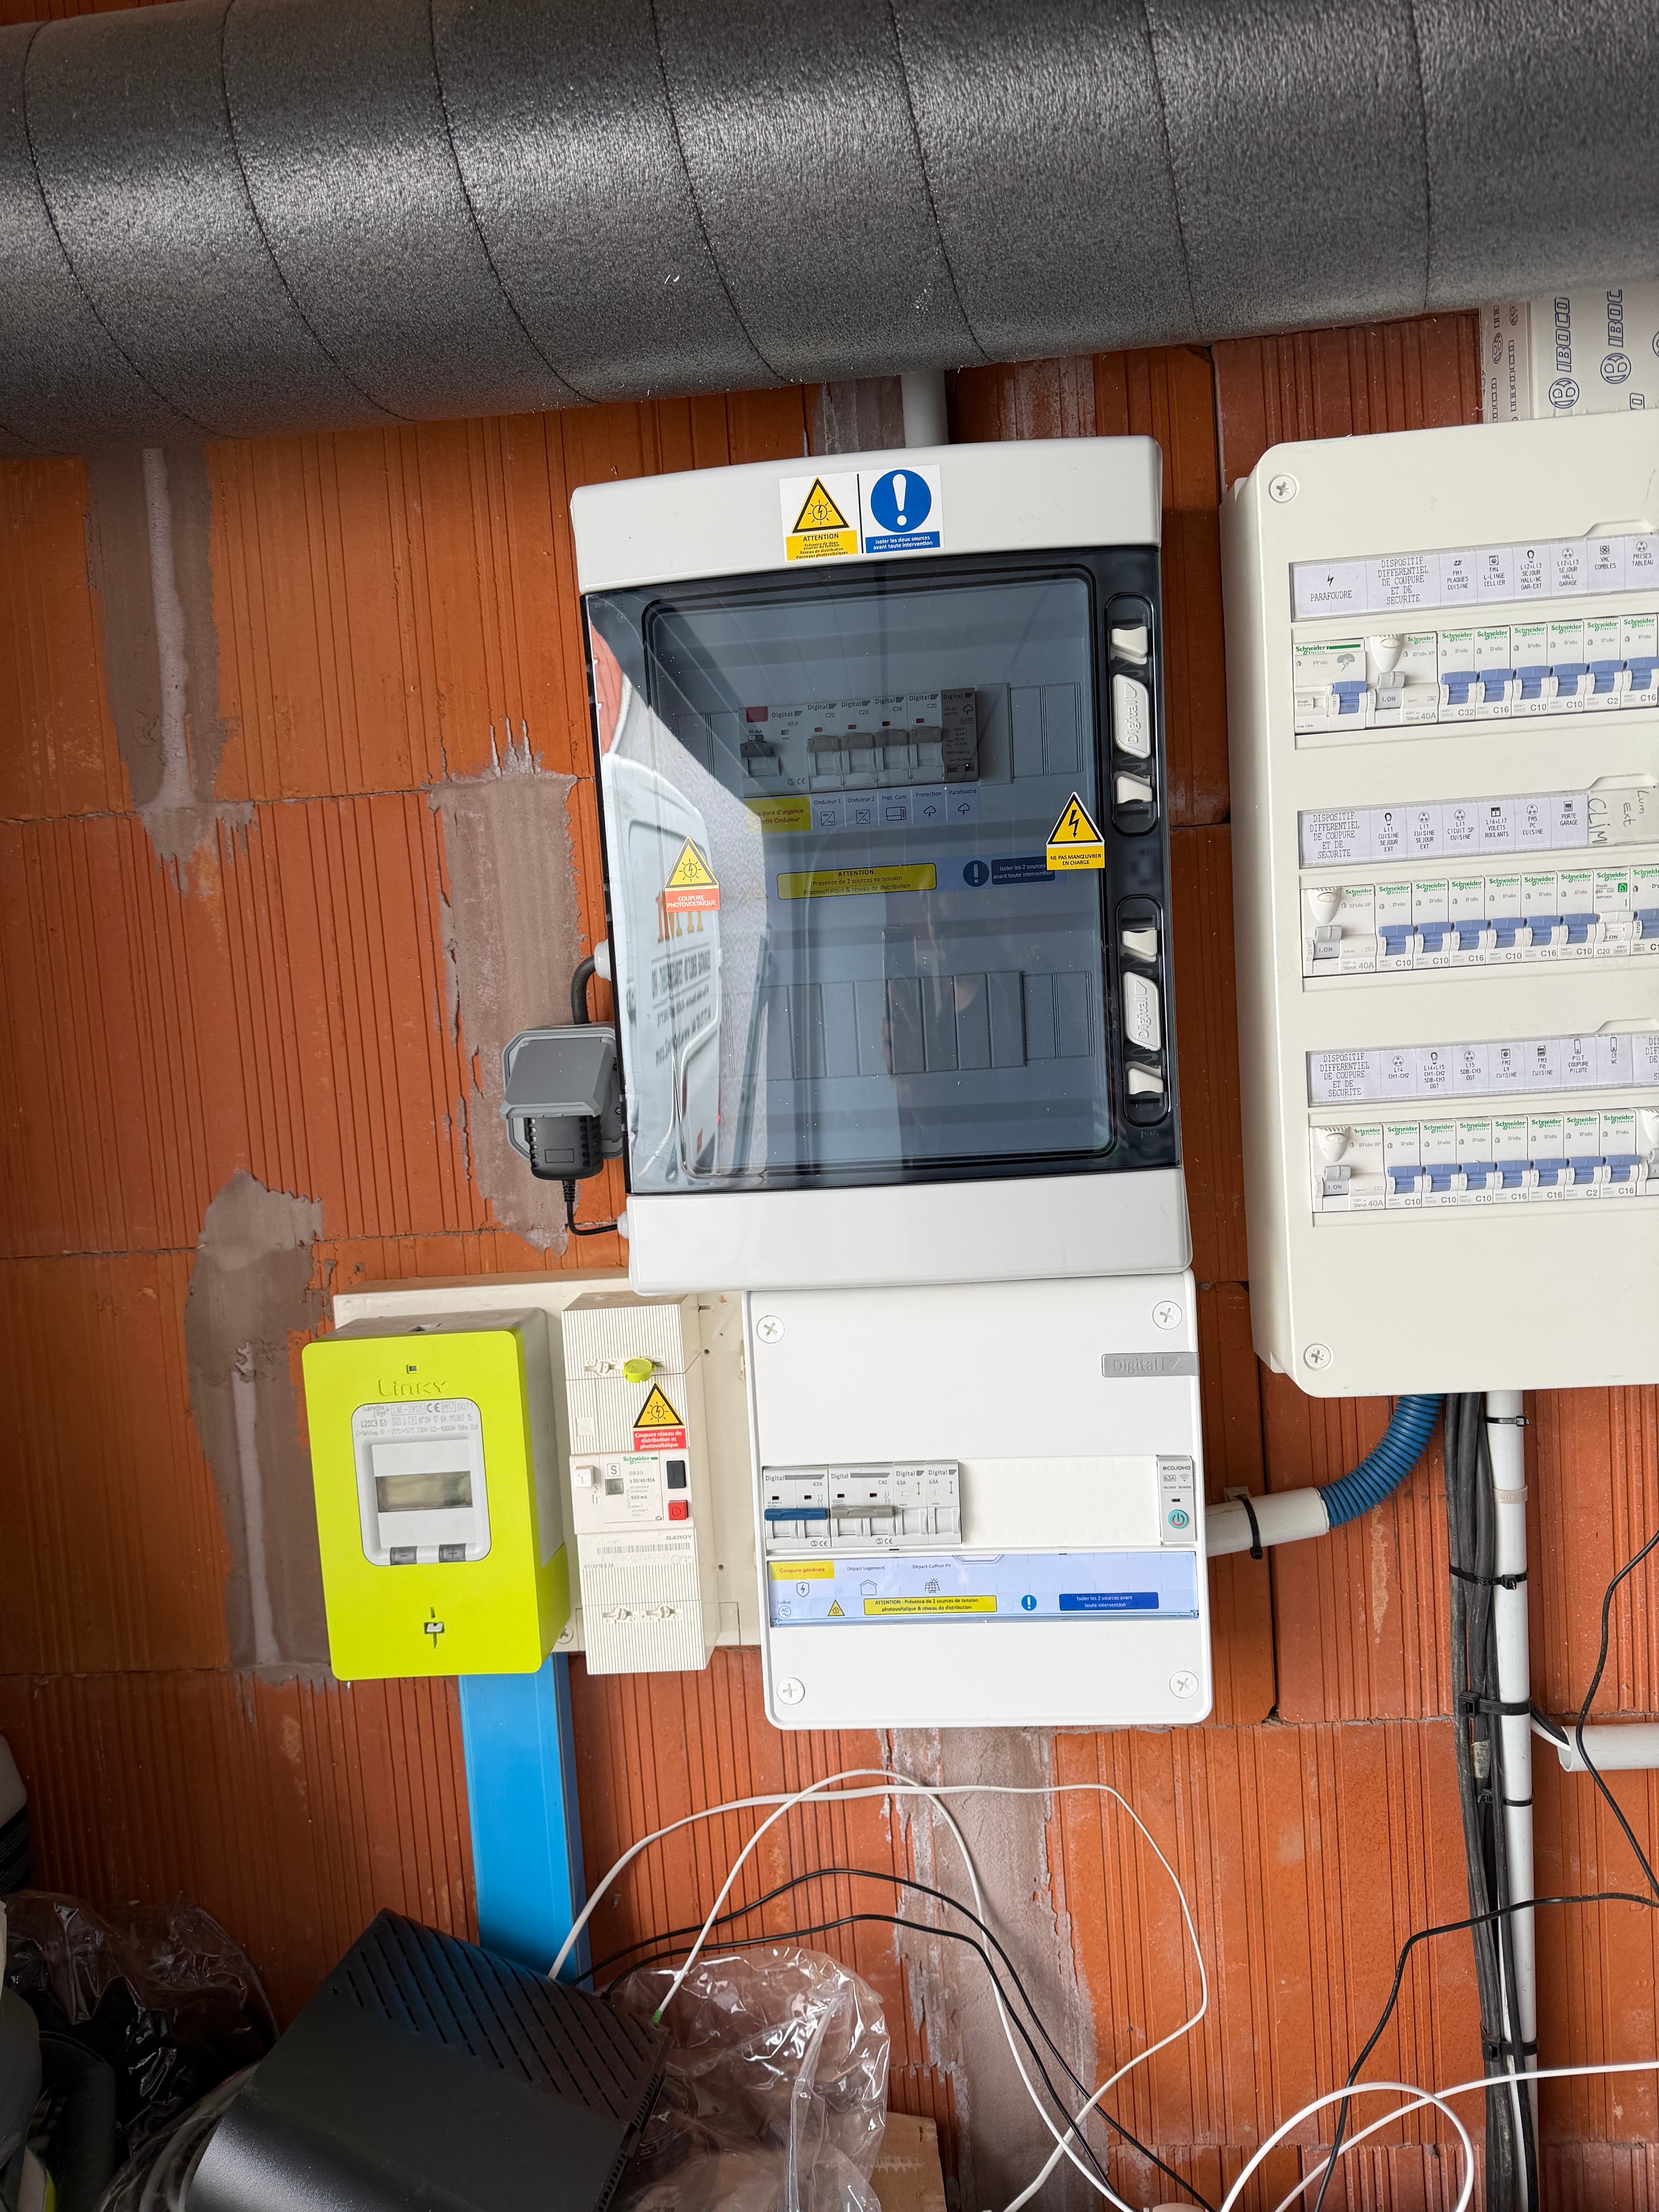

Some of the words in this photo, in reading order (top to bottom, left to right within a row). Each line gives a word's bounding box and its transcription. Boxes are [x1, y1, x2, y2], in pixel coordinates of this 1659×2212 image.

[1554, 297, 1572, 372] IBOCO
[803, 533, 839, 542] ATTENTION
[1381, 556, 1424, 568] DISPOSITIF
[1378, 566, 1429, 578] DIFFERENTIEL
[1382, 578, 1390, 586] DE
[1395, 575, 1424, 585] COUPURE
[1404, 586, 1412, 594] DE
[1310, 590, 1352, 602] PARAFOUDRE
[1387, 594, 1420, 604] SECURITE
[1624, 618, 1655, 628] Schneider
[1515, 626, 1545, 636] Schneider
[909, 694, 929, 702] Digital
[807, 702, 828, 711] Digital
[841, 700, 861, 709] Digital
[757, 809, 775, 818] oupure
[1313, 812, 1354, 823] DISPOSITIF
[1310, 821, 1360, 832] DIFFERENTIEL
[1326, 831, 1355, 839] COUPURE
[1318, 849, 1351, 859] SECURITE
[1597, 872, 1628, 881] Schneider
[667, 899, 716, 908] PHOTOVOLTAÏQUE
[1135, 997, 1151, 1039] Digital
[1323, 1053, 1364, 1062] DISPOSITIF
[1320, 1062, 1370, 1072] DIFFERENTIEL
[1336, 1071, 1365, 1079] COUPURE
[1328, 1088, 1361, 1097] SECURITE
[1604, 1115, 1634, 1124] Schneider
[1113, 1357, 1159, 1374] Digital
[458, 1402, 473, 1411] 0071
[623, 1456, 650, 1465] Schneider
